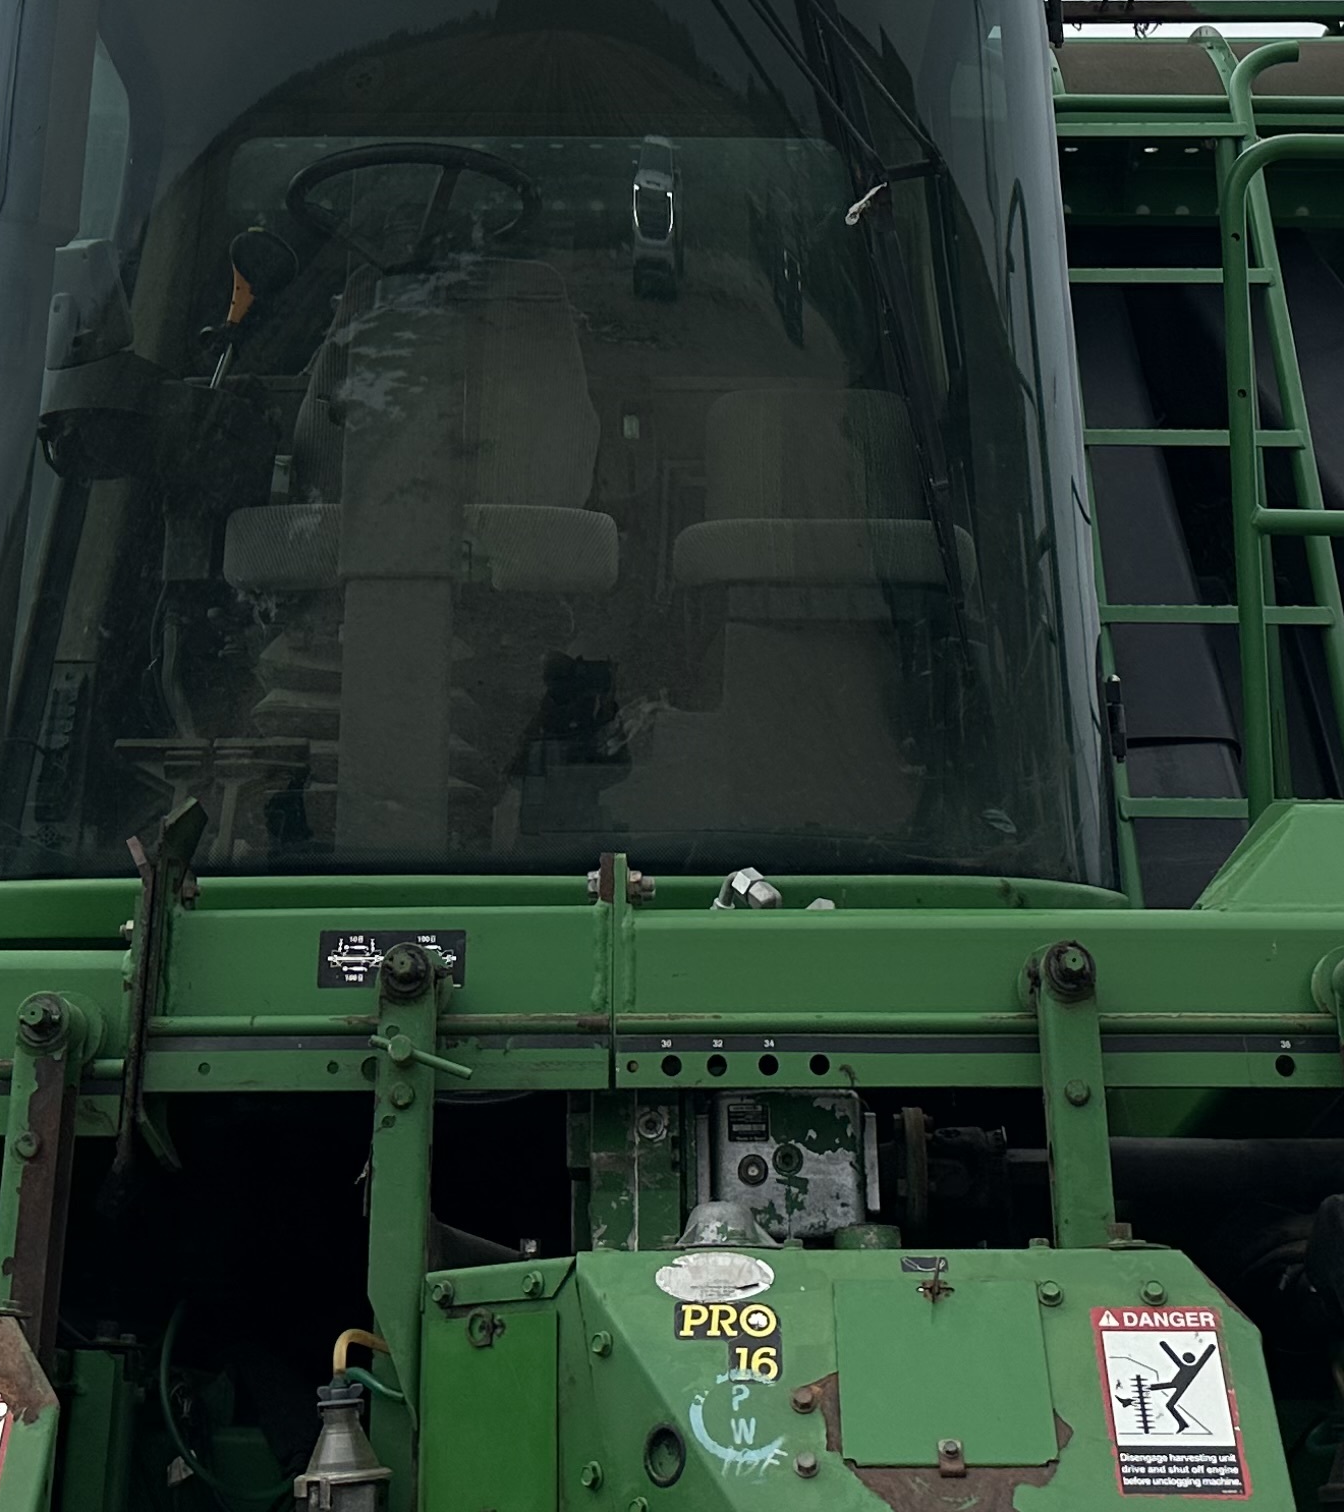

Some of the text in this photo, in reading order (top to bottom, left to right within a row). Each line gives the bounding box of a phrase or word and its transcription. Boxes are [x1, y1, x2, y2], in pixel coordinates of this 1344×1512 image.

[661, 1039, 672, 1048] 30
[712, 1039, 723, 1048] 32
[764, 1039, 775, 1048] 34
[679, 1303, 777, 1338] PRO
[1122, 1311, 1216, 1327] DANGER
[735, 1346, 779, 1381] 16
[730, 1417, 756, 1445] W
[1119, 1453, 1237, 1464] Disengage harvesting unit
[1121, 1465, 1239, 1476] drive and shut off engine
[1122, 1476, 1242, 1488] before unclogging machine.
